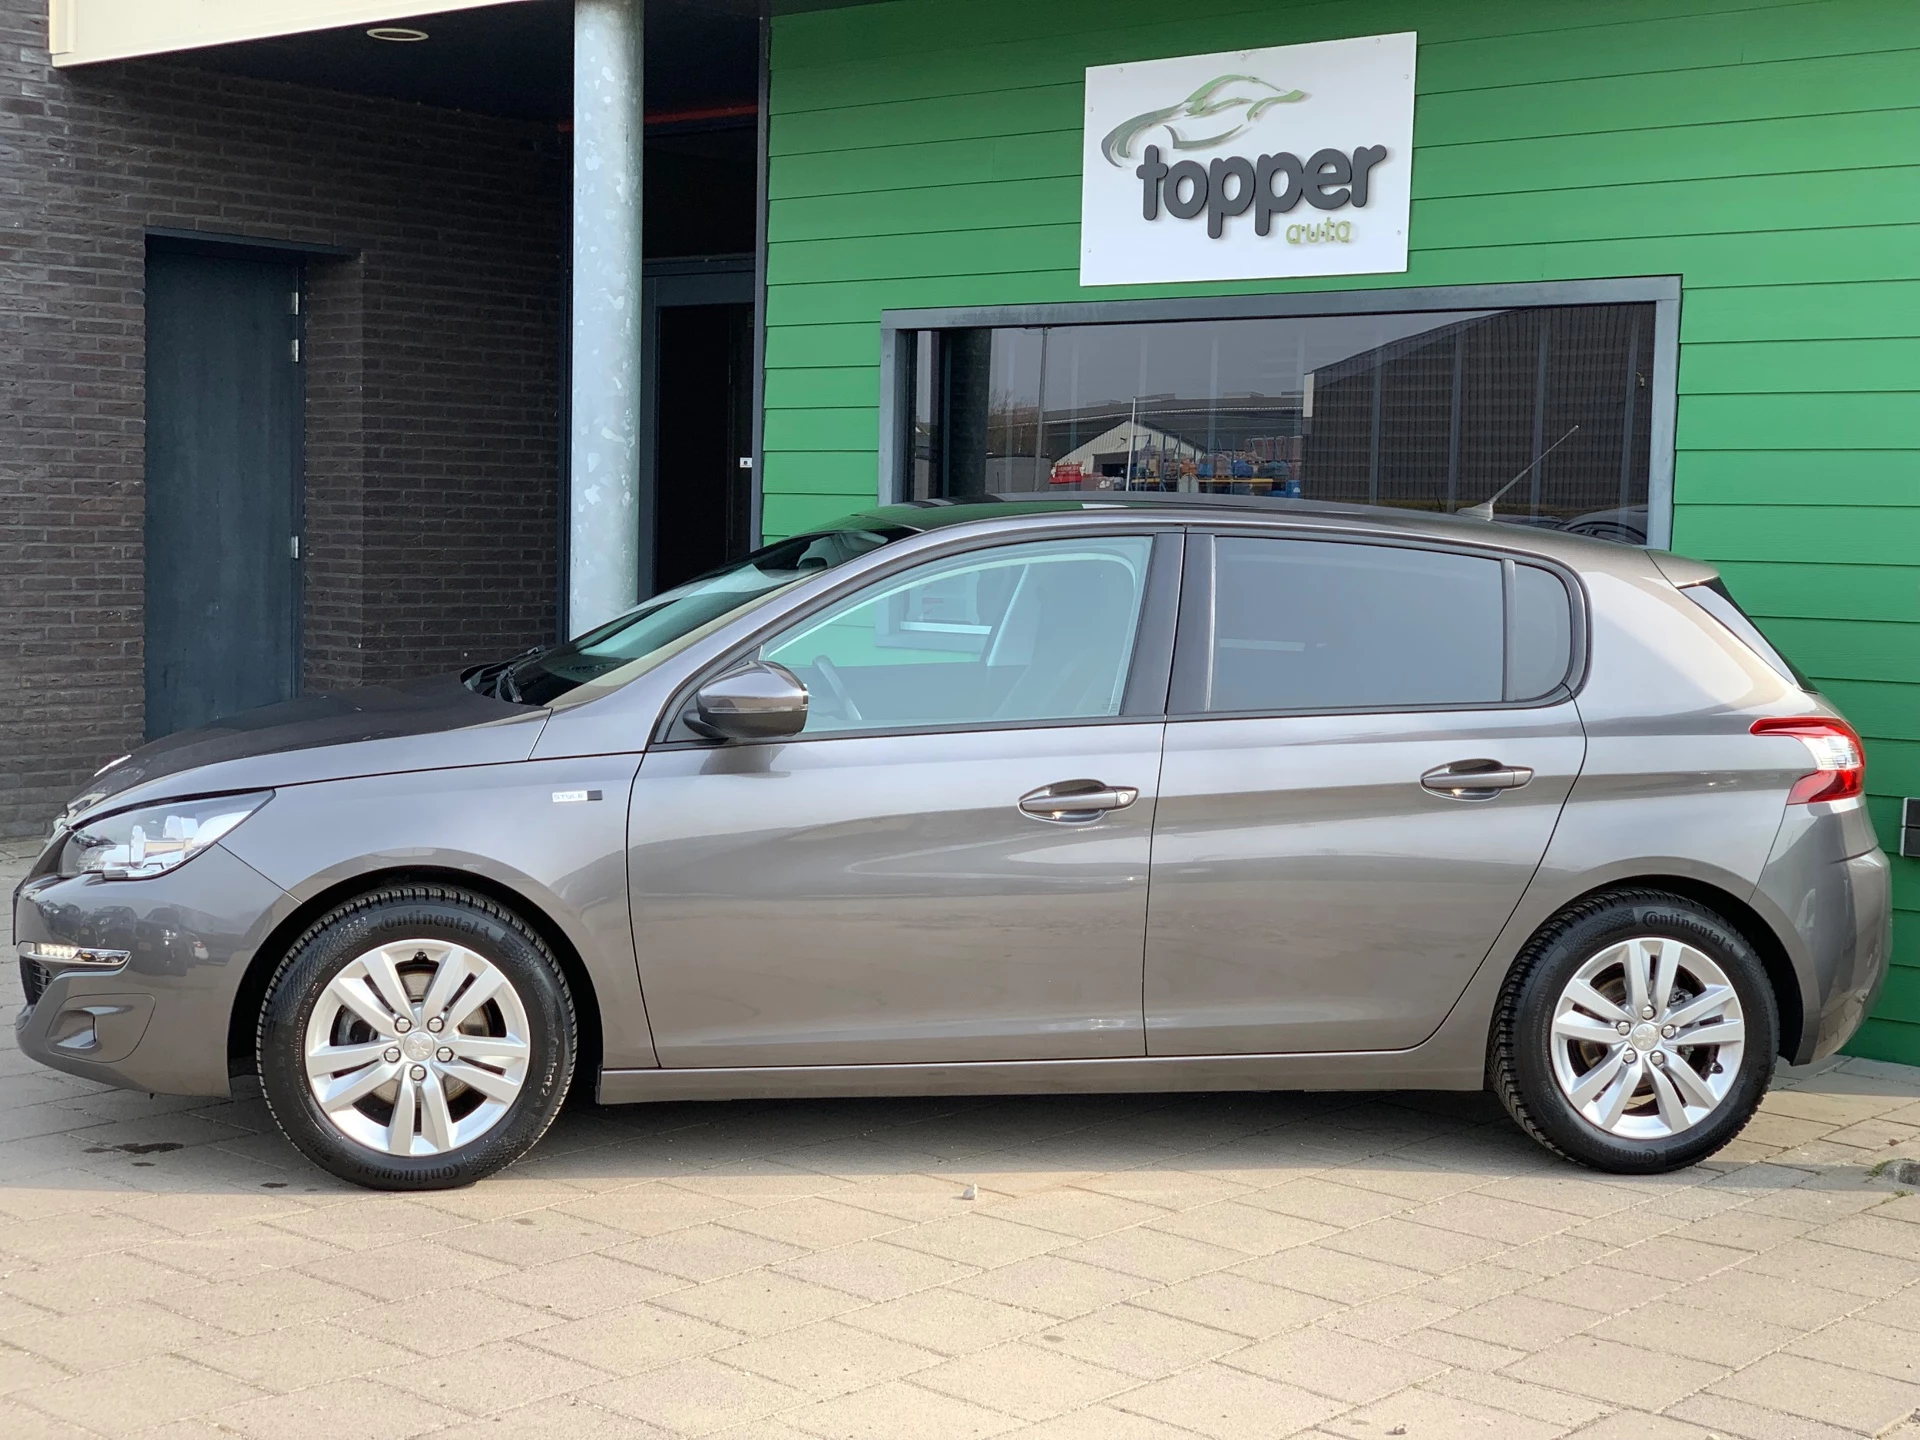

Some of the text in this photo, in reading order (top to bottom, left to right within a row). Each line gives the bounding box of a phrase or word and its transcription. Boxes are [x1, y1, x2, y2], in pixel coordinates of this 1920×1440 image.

[1136, 144, 1387, 239] topper
[379, 910, 479, 935] Continental
[1642, 911, 1727, 946] Continental
